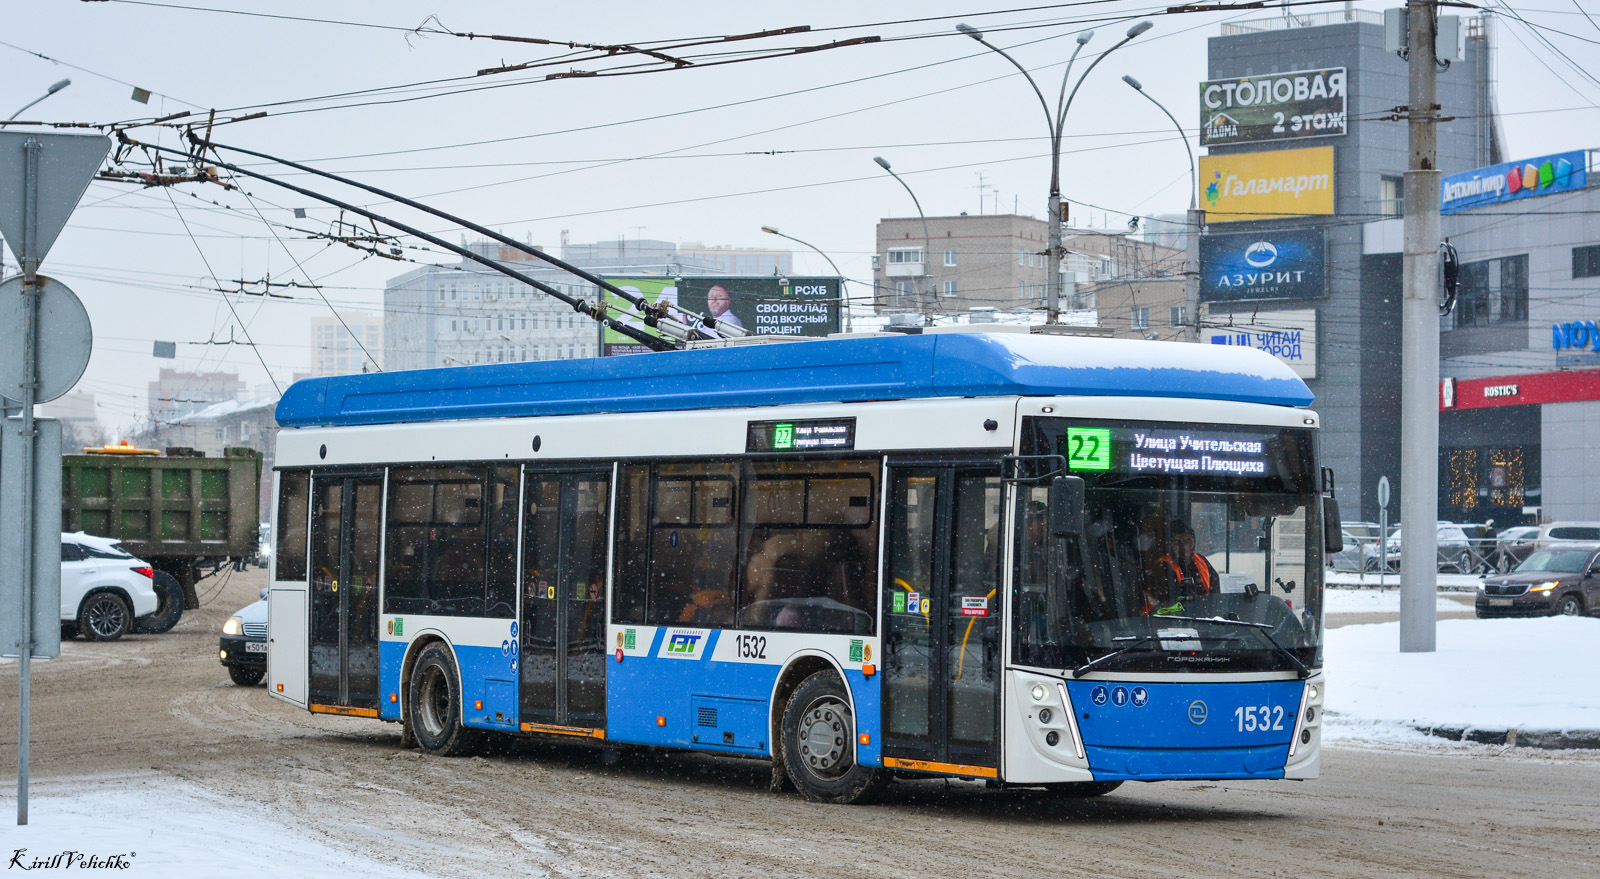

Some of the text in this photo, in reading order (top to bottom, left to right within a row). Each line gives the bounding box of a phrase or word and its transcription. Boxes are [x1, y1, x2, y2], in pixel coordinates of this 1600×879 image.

[1204, 73, 1344, 109] СТОЛОВАЯ
[1272, 111, 1344, 133] 2 этаж
[1223, 174, 1329, 198] Галамарт
[1443, 174, 1505, 203] Детский мир
[1218, 270, 1305, 287] АЗУРИТ
[795, 285, 827, 295] РСХБ
[756, 313, 828, 325] ПОД ВКУСНЫЙ
[790, 303, 828, 314] ВКЛАД
[756, 325, 803, 335] ПРОЦЕНТ
[1483, 384, 1519, 398] ROSTIC'S
[1070, 434, 1101, 462] 22
[1134, 433, 1262, 454] Улица Учительская
[1130, 453, 1265, 475] Цветущая Плющиха
[735, 634, 767, 660] 1532
[1235, 705, 1285, 733] 1532
